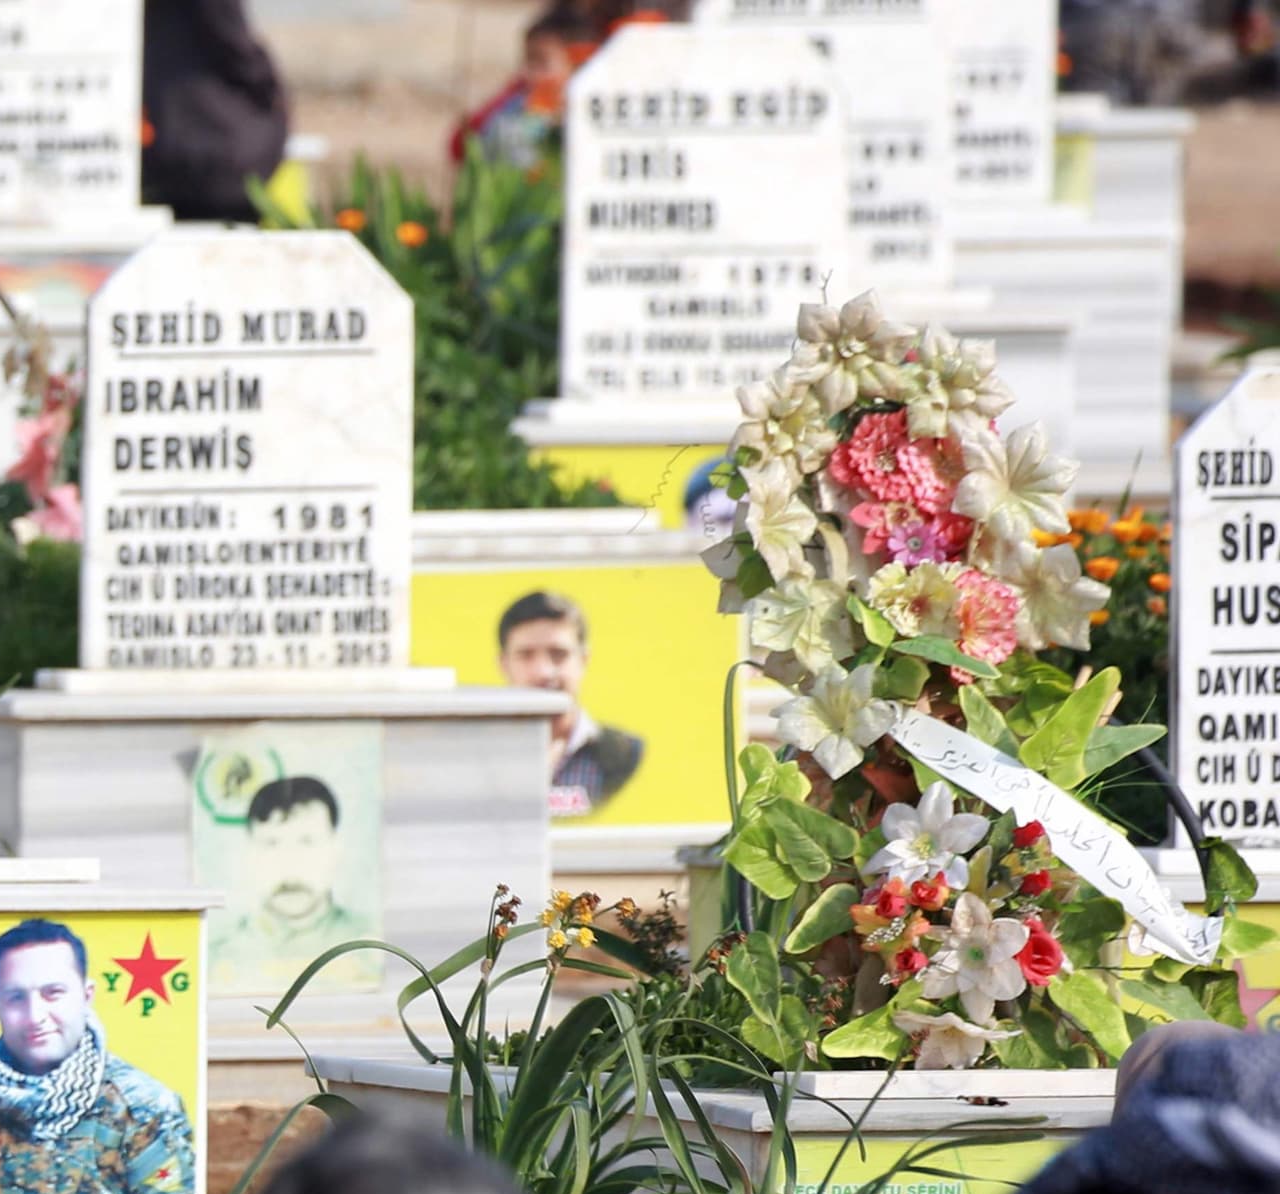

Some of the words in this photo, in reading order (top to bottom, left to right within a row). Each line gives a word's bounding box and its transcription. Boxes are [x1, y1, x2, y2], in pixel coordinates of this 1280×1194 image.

[241, 308, 367, 343] MURAD
[1220, 513, 1280, 562] SİP
[1197, 755, 1236, 784] CIH
